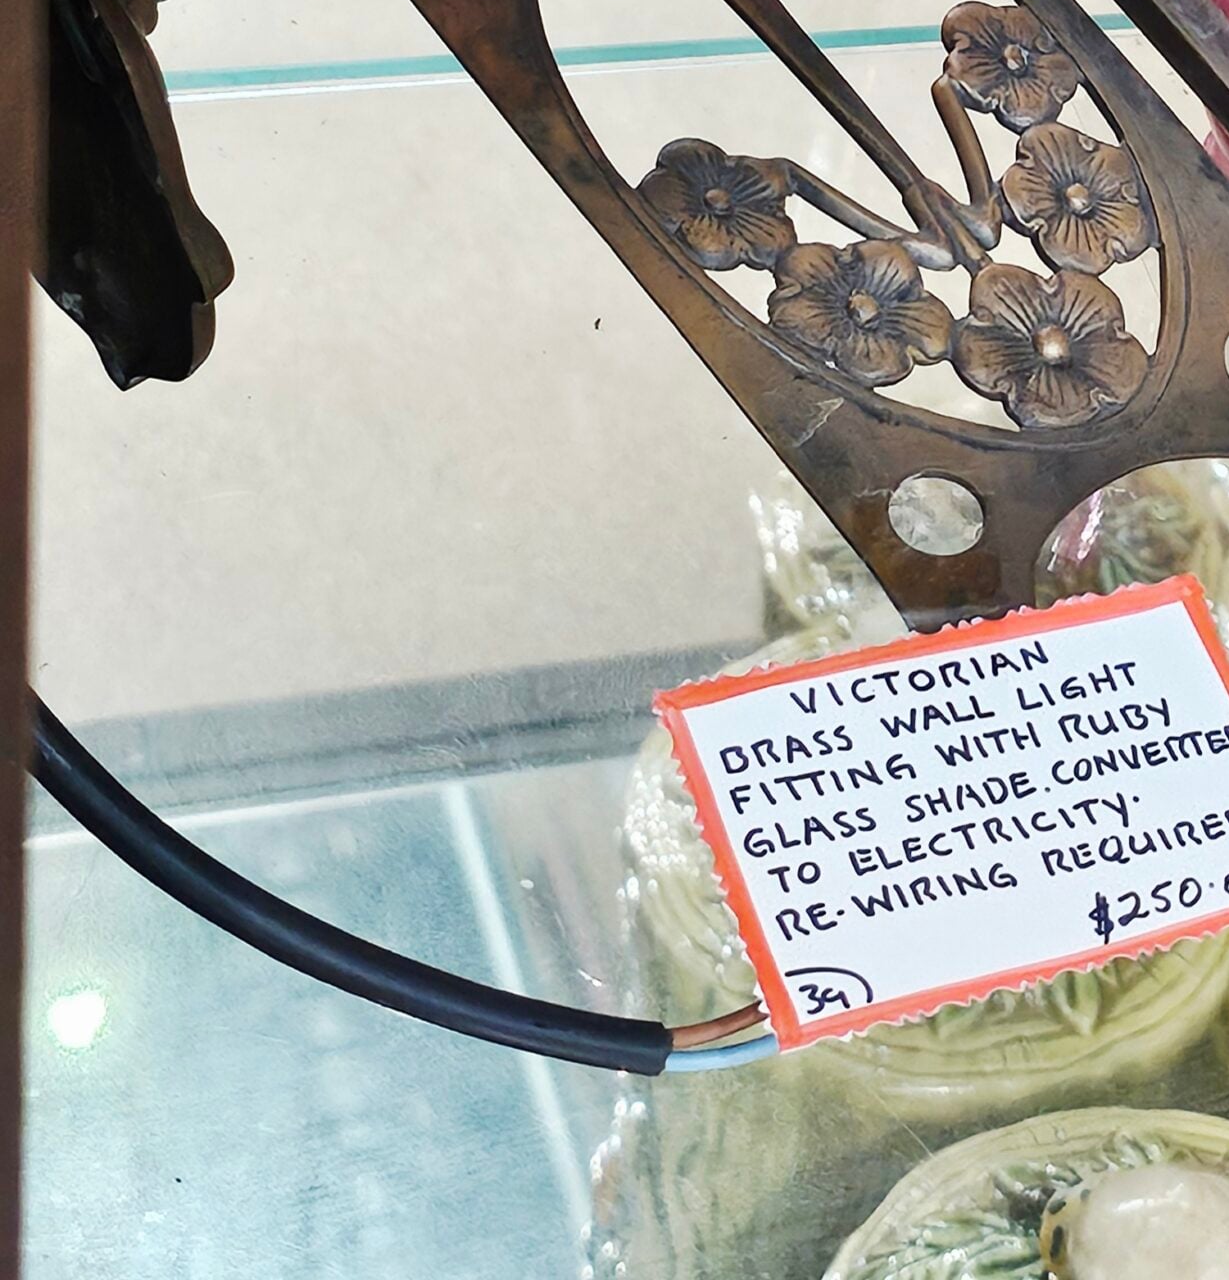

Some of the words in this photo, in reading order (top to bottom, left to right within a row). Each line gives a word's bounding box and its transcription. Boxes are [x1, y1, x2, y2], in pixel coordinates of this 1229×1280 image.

[789, 641, 1050, 714] VICTORIAN
[719, 725, 853, 774] BRASS
[880, 695, 996, 739] WALL
[1016, 661, 1136, 710] LIGHT
[728, 754, 917, 814] FITTING
[934, 724, 1041, 768] WITH
[1060, 698, 1172, 744] RUBY
[743, 806, 877, 859] GLASS
[769, 860, 821, 893] TO
